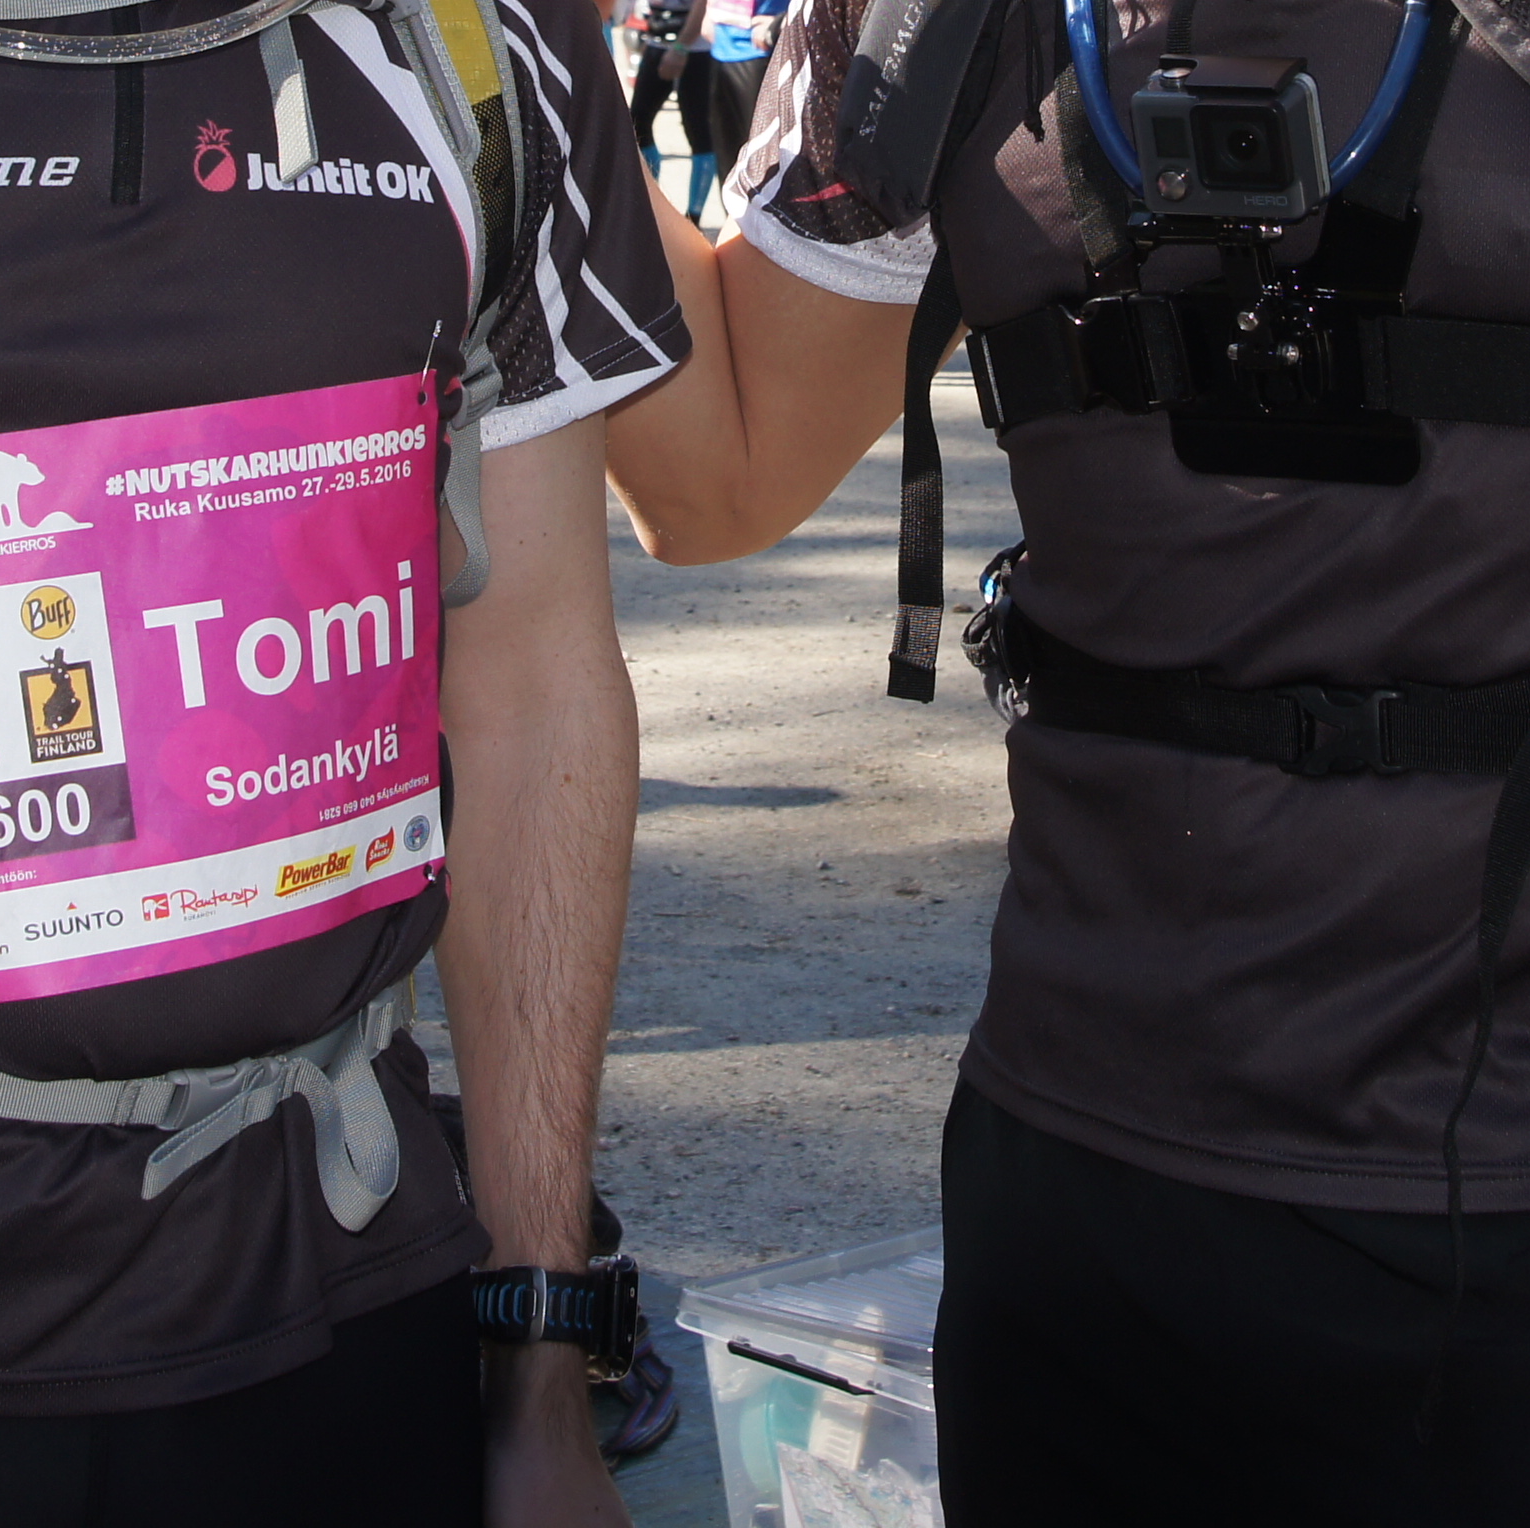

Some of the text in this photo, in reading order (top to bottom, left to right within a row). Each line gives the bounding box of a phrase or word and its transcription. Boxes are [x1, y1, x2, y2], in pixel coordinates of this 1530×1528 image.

[375, 160, 435, 204] OK
[1243, 195, 1288, 207] HERO
[134, 459, 412, 522] Ruka Kuusamo 27.-29.5.2016
[142, 559, 415, 709] Tomi
[35, 730, 94, 747] TRAIL TOUR
[36, 739, 97, 759] FINLAND
[205, 723, 400, 807] Sodankylä
[359, 793, 375, 809] 040
[280, 851, 352, 889] PowerBar
[24, 909, 125, 942] SUUNTO
